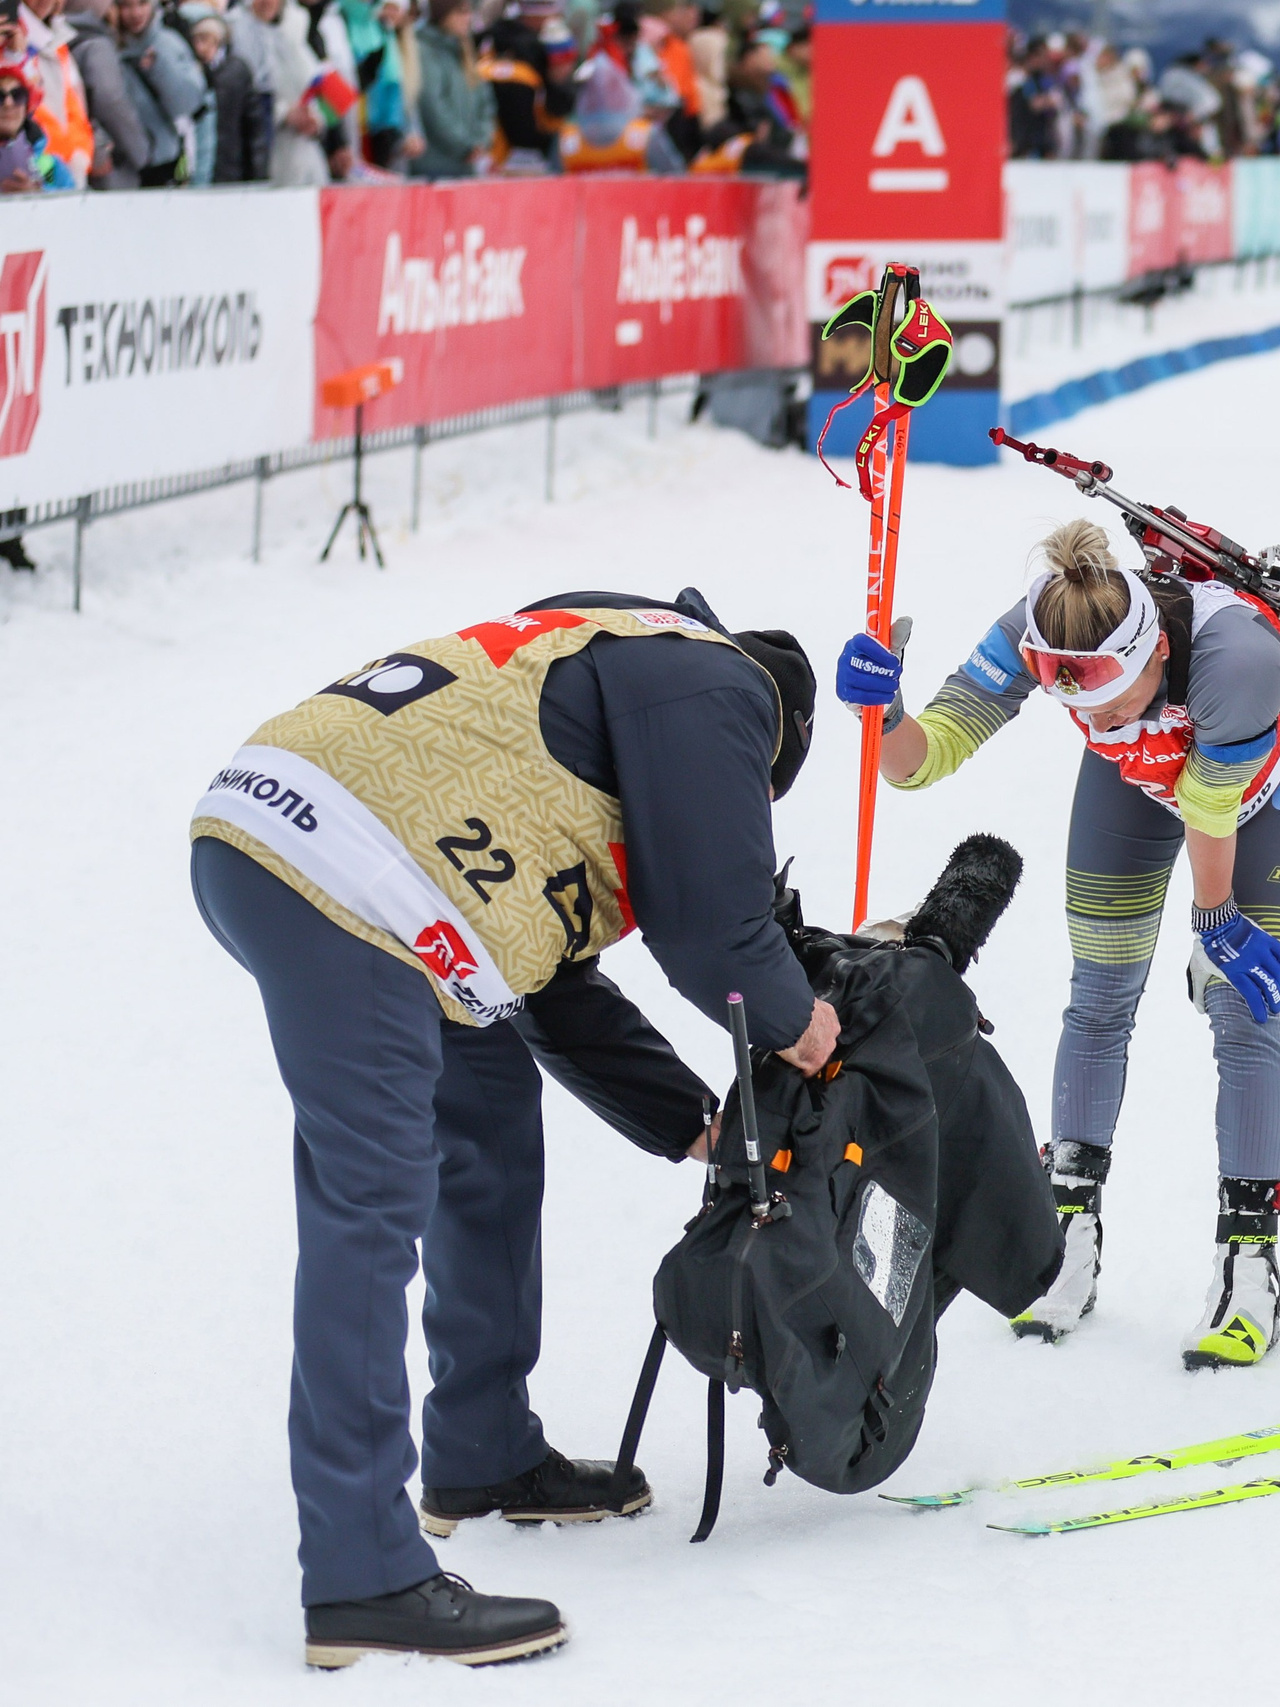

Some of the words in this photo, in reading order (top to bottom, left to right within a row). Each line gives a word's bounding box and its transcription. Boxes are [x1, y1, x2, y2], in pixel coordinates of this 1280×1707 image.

[57, 291, 262, 386] ТЕХНОНИКОЛЬ
[857, 424, 882, 468] LEKI
[1142, 743, 1188, 765] Бан
[435, 817, 516, 905] 22
[1227, 1235, 1278, 1243] FISCHE
